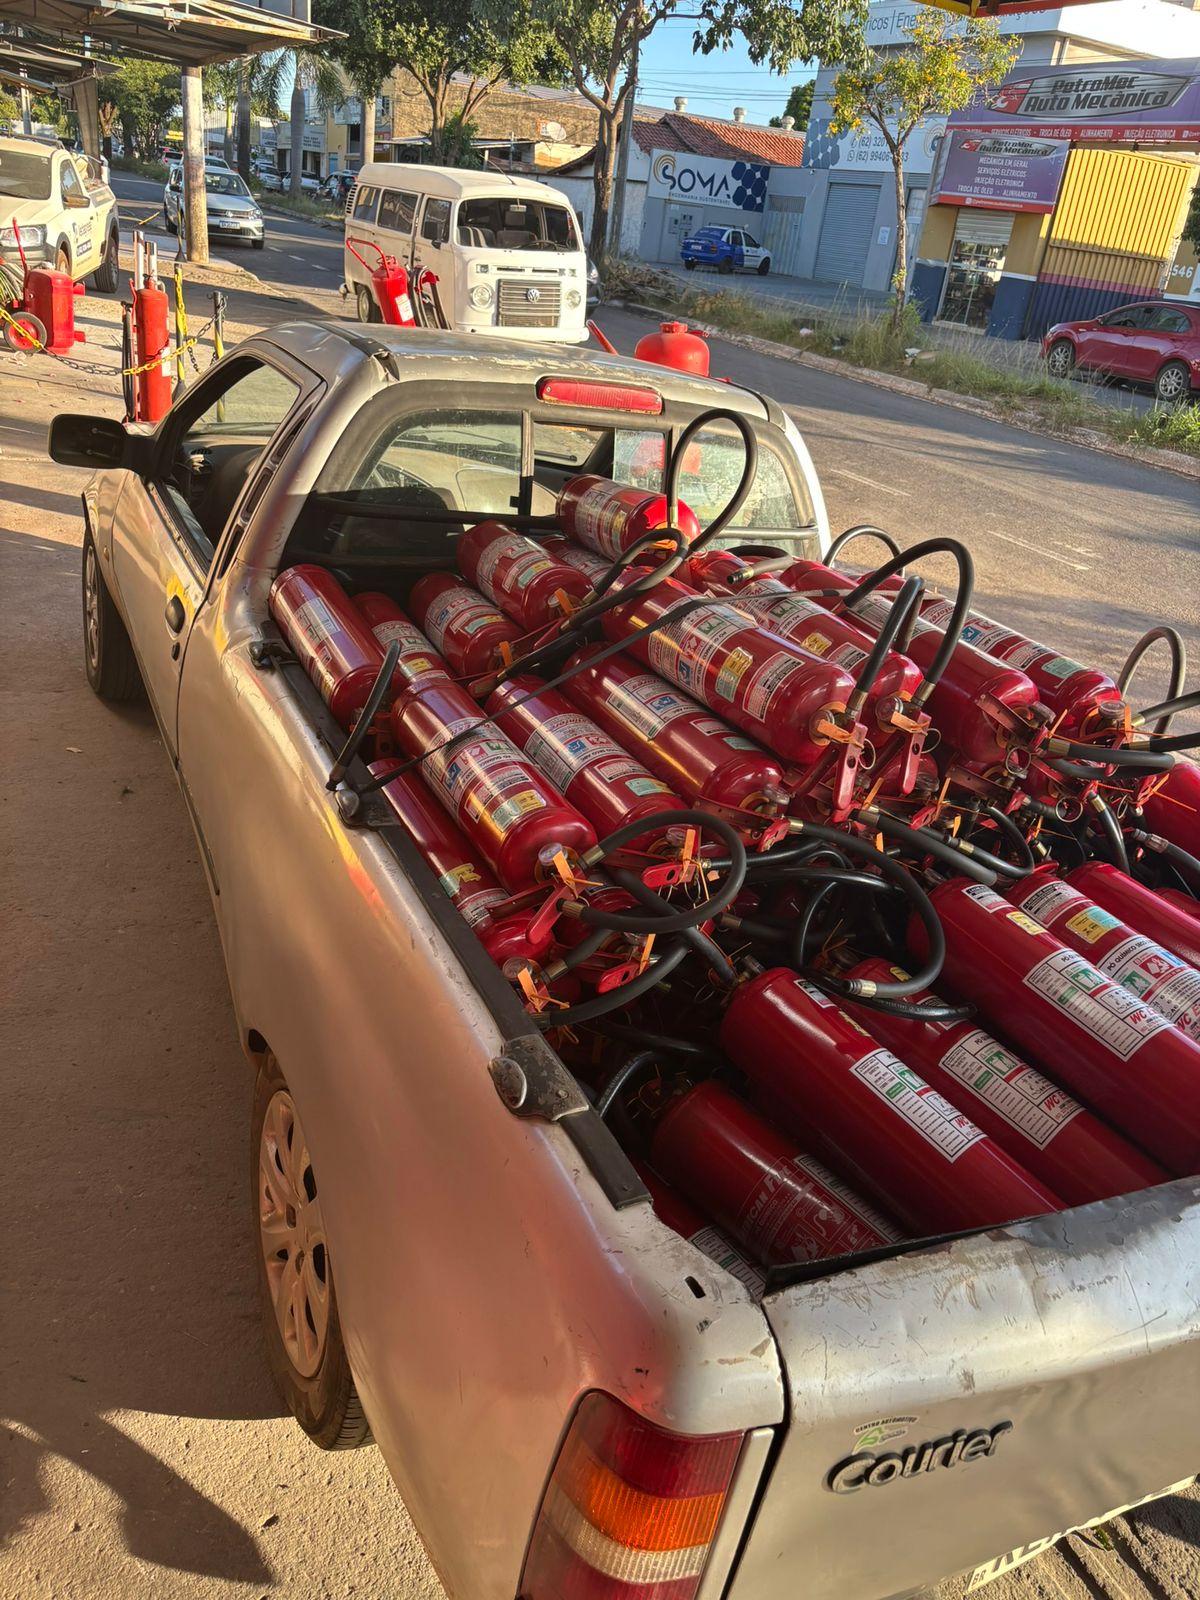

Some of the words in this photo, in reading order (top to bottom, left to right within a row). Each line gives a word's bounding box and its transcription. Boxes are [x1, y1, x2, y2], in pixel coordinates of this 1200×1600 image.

[1053, 75, 1140, 94] PetroMec
[1024, 93, 1067, 112] Auto
[1070, 88, 1170, 110] Mecânica
[1080, 129, 1114, 138] ALINHAMENTO
[980, 143, 1003, 153] Auto
[856, 150, 869, 162] (62)
[980, 157, 1004, 166] MECÂNICA
[1013, 160, 1029, 168] GERAL
[977, 167, 1000, 176] SERVIÇOS
[661, 164, 731, 200] SOMA
[958, 185, 972, 193] TROCA
[1002, 189, 1037, 199] ALINHAMENTO
[1171, 264, 1194, 278] 546
[1106, 961, 1116, 971] PÓ
[1129, 1009, 1147, 1025] WC
[1043, 1092, 1060, 1111] WC
[824, 1420, 1014, 1495] Courier
